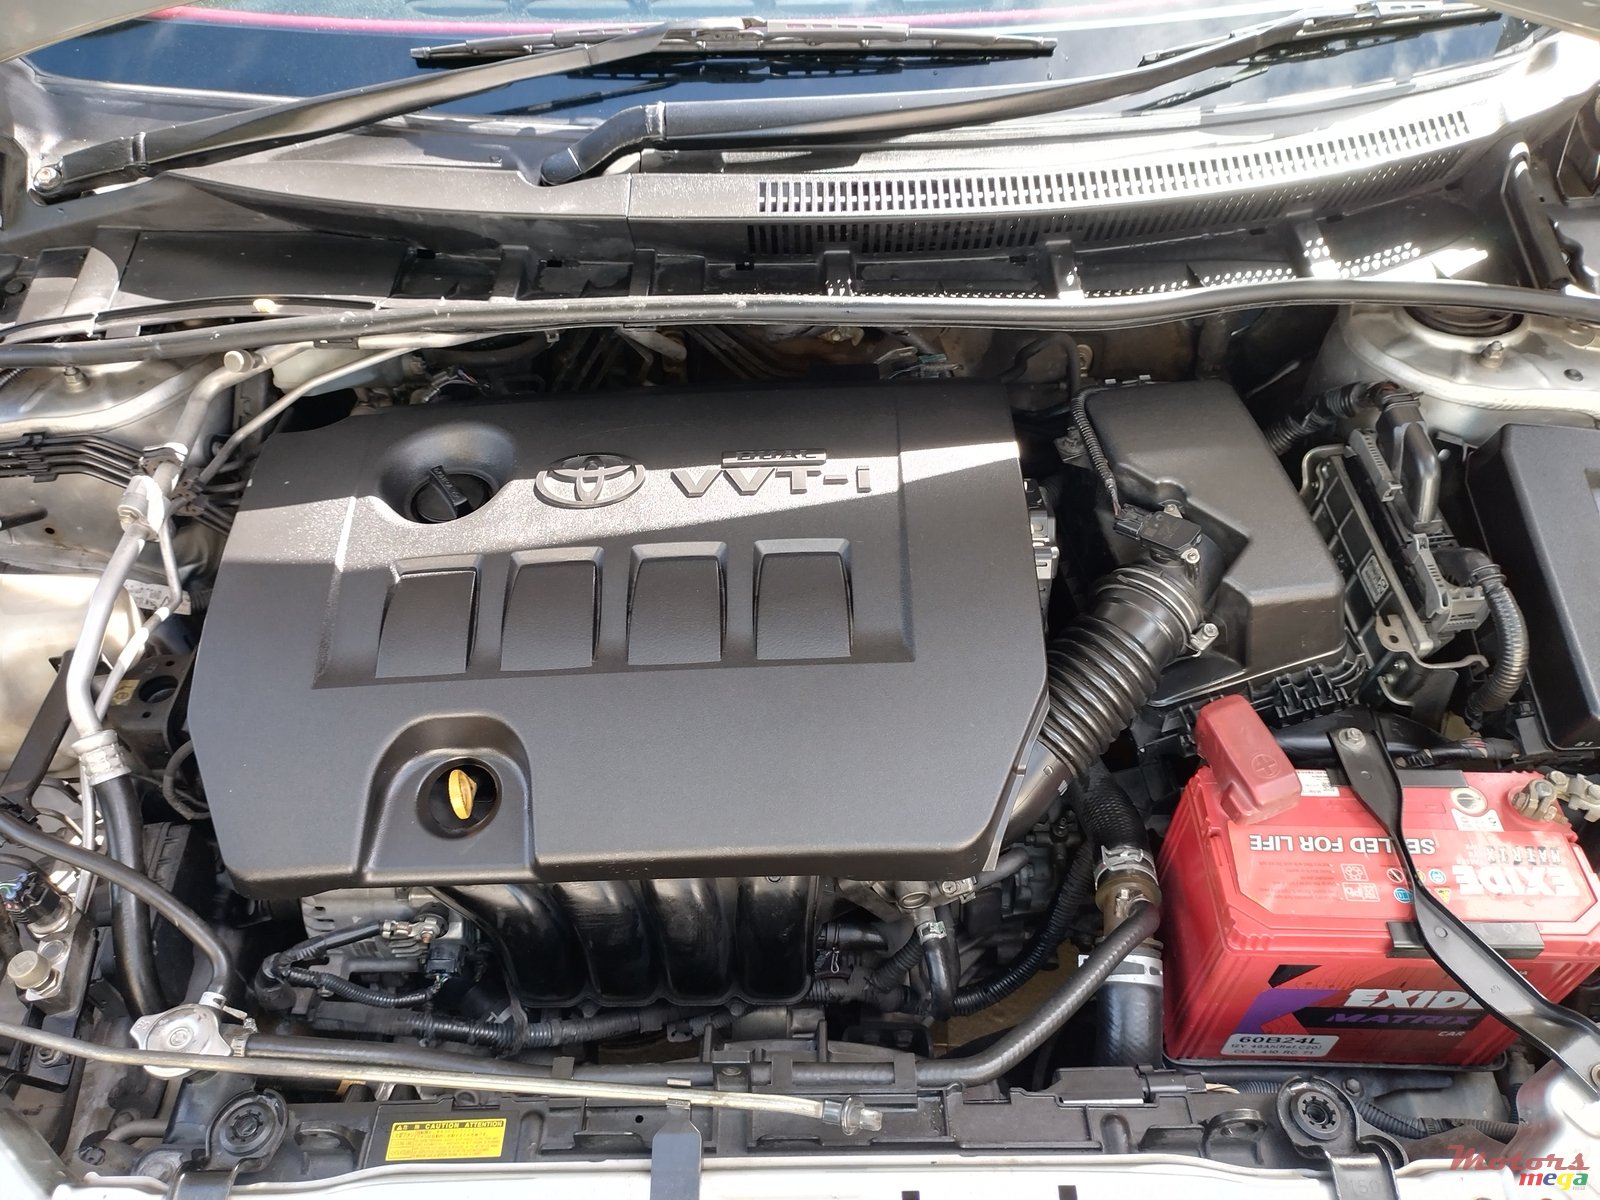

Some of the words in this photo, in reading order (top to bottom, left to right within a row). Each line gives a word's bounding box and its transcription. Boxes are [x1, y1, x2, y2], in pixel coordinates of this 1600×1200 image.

[737, 450, 819, 461] DUAL
[1249, 834, 1293, 851] LIFE
[1299, 836, 1344, 852] FOR
[1350, 837, 1436, 855] SELED
[1486, 846, 1562, 866] MATRIX
[1452, 865, 1580, 897] EXIDE
[1327, 1012, 1475, 1026] MATRIX
[1239, 1036, 1321, 1045] 60B24L
[1438, 1030, 1465, 1038] CAR
[425, 1122, 460, 1130] CAUTION
[464, 1120, 503, 1129] ATTENTION
